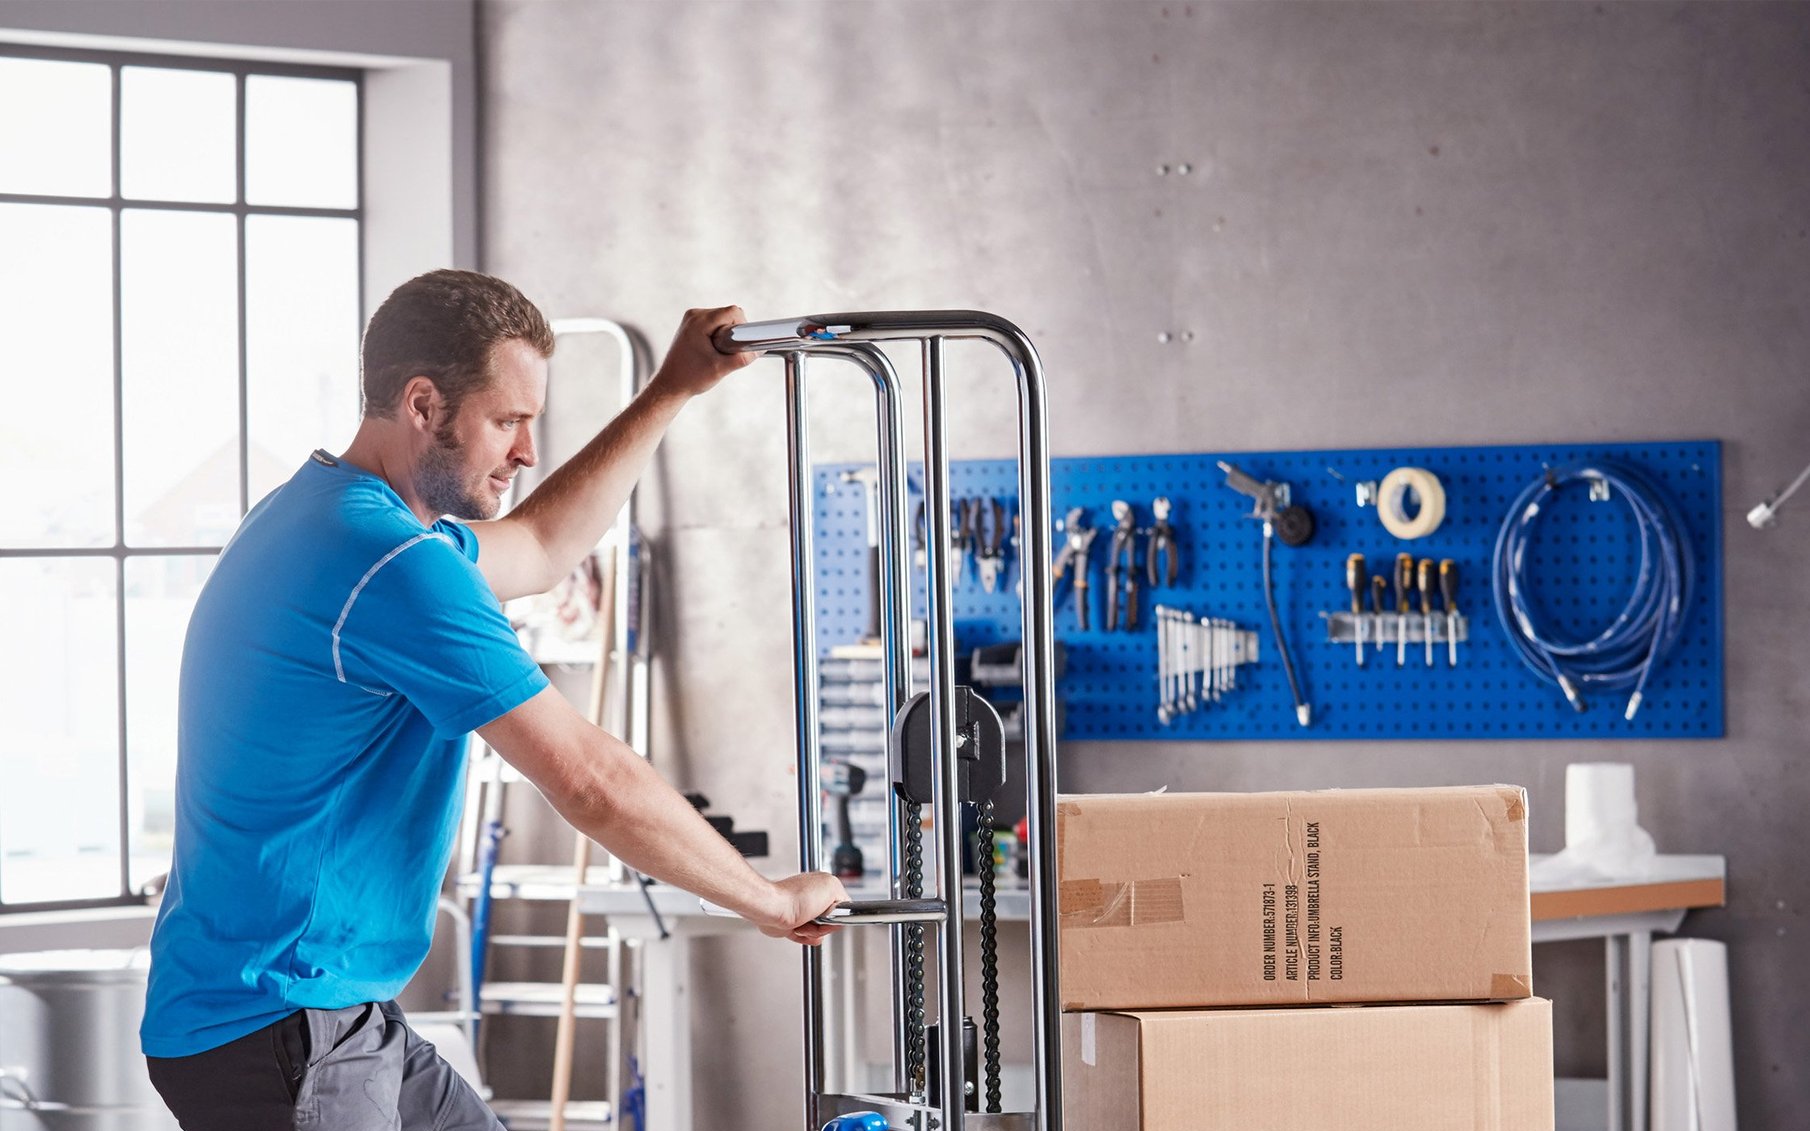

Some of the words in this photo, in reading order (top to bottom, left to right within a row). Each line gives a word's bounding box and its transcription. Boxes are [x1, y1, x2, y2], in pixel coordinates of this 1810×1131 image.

[1307, 822, 1320, 848] BLACK
[1307, 850, 1321, 878] STAND,
[1263, 883, 1276, 952] NUMBER:571873-1
[1307, 880, 1320, 942] INFO:UMBRELLA
[1263, 954, 1276, 981] ORDER
[1285, 949, 1298, 981] ARTICLE
[1307, 944, 1320, 981] PRODUCT
[1330, 926, 1343, 981] COLOR:BLACK
